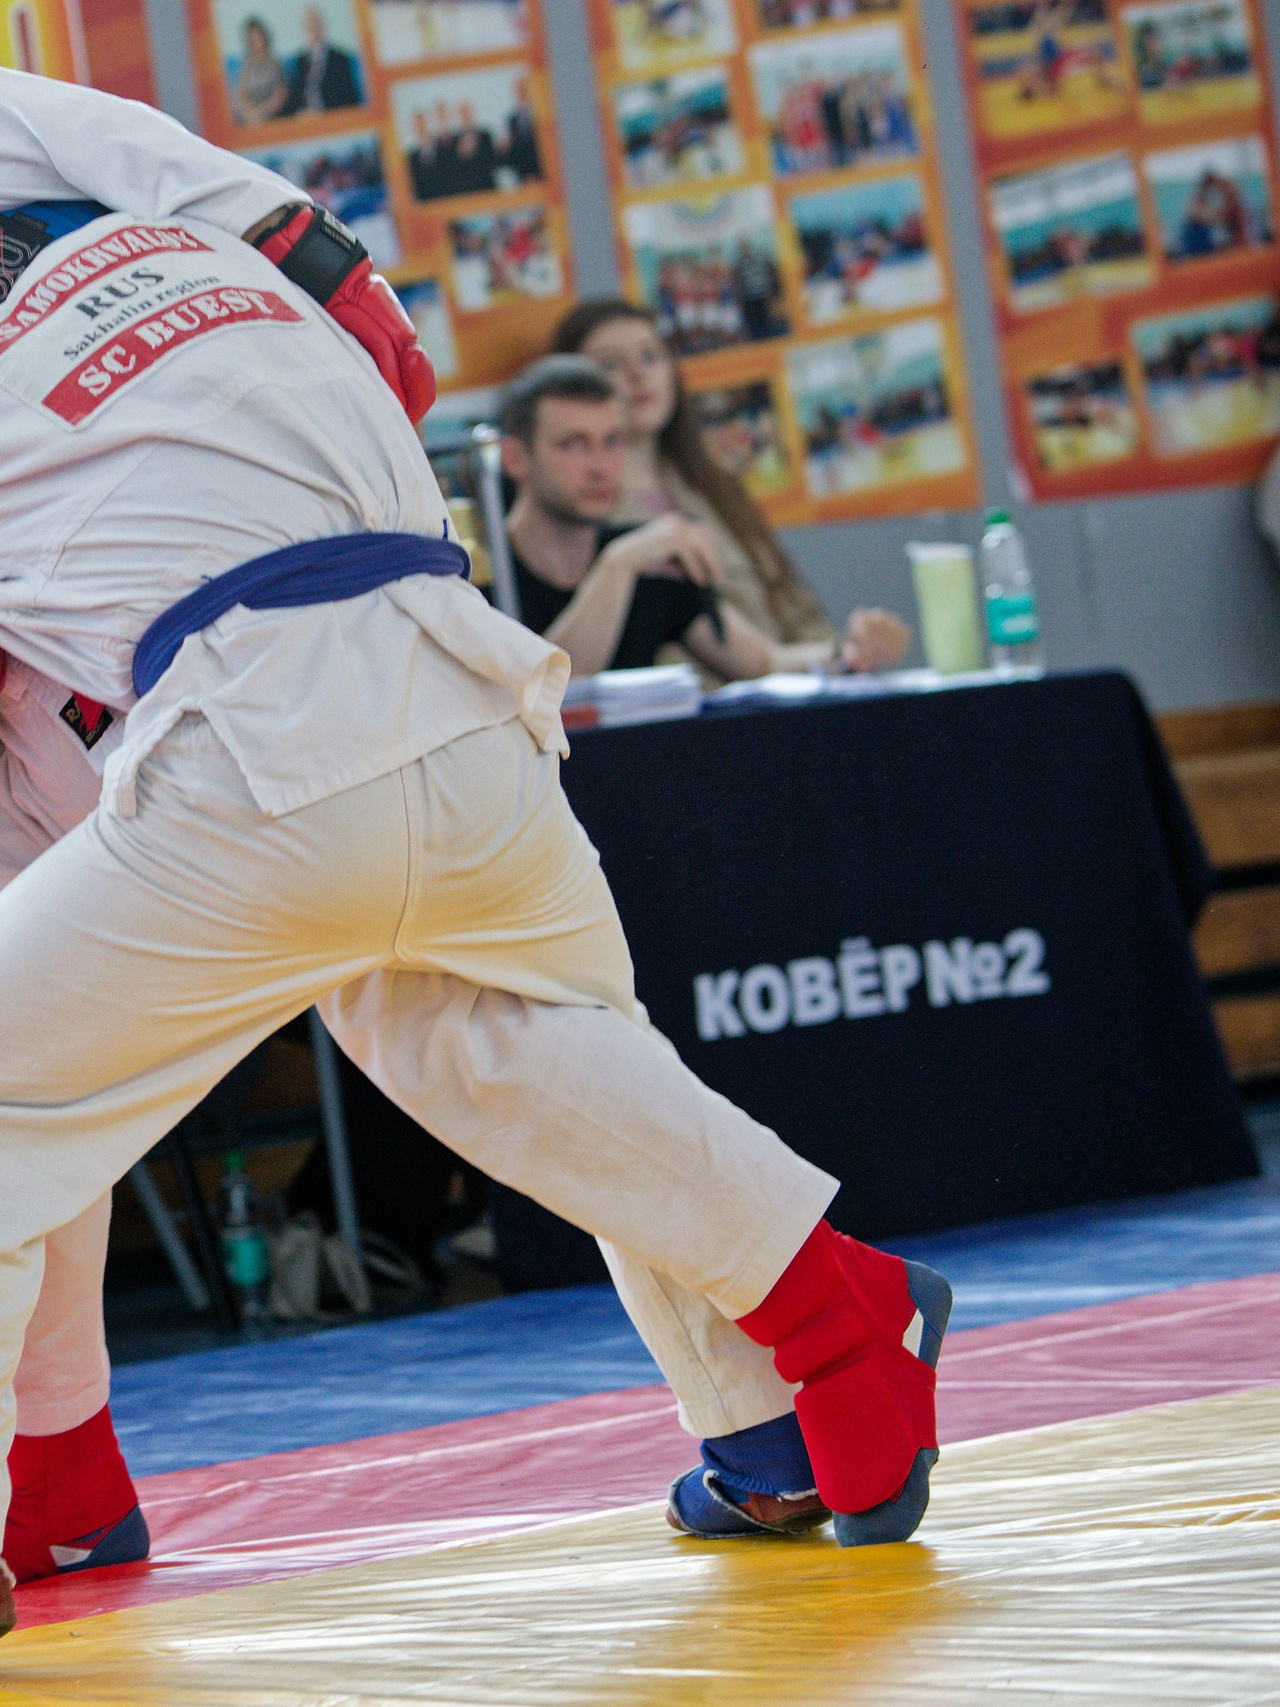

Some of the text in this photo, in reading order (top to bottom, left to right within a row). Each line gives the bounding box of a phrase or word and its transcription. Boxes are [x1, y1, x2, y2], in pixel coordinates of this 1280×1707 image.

[63, 275, 220, 361] Sakhalin region
[75, 266, 165, 320] RUS
[77, 344, 136, 396] SC
[693, 935, 921, 1042] КОВЁР
